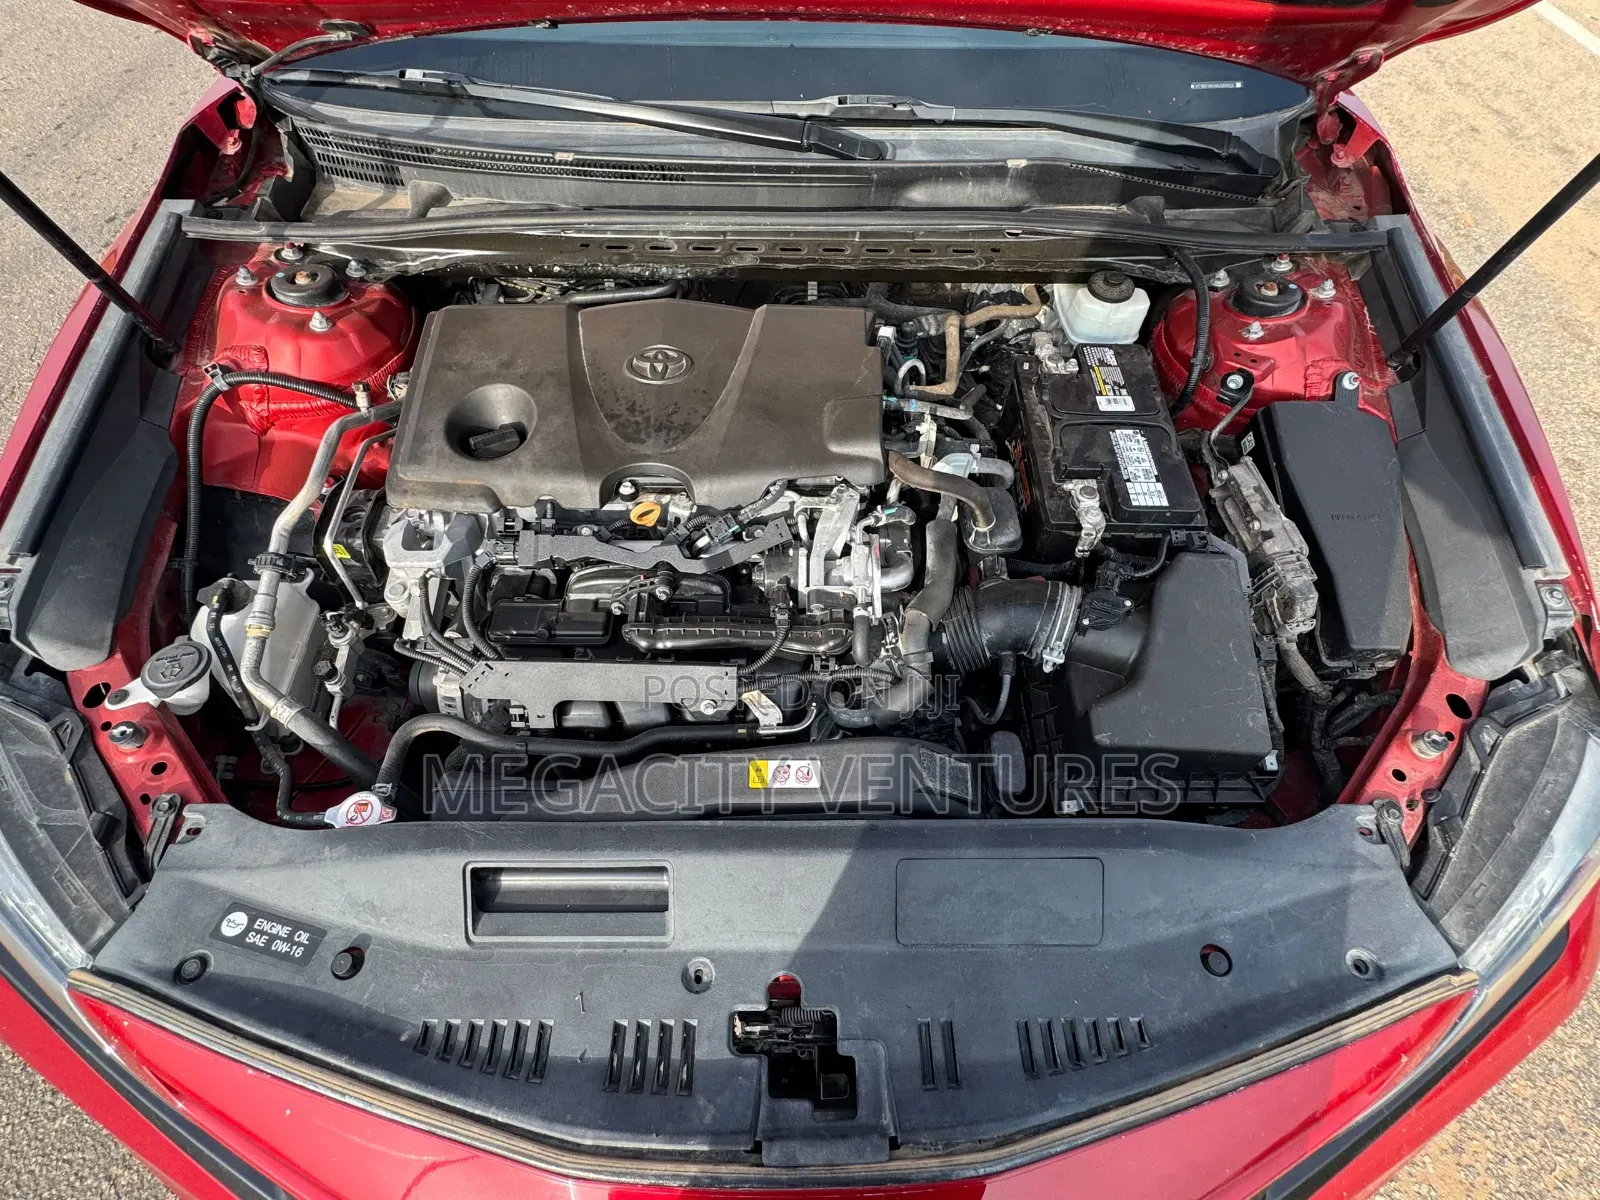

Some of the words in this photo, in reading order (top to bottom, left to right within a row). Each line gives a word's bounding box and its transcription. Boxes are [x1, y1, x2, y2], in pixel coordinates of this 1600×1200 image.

[245, 931, 269, 947] SAE
[271, 940, 304, 957] 0W-16
[253, 918, 292, 937] ENGINE
[294, 930, 310, 944] OIL
